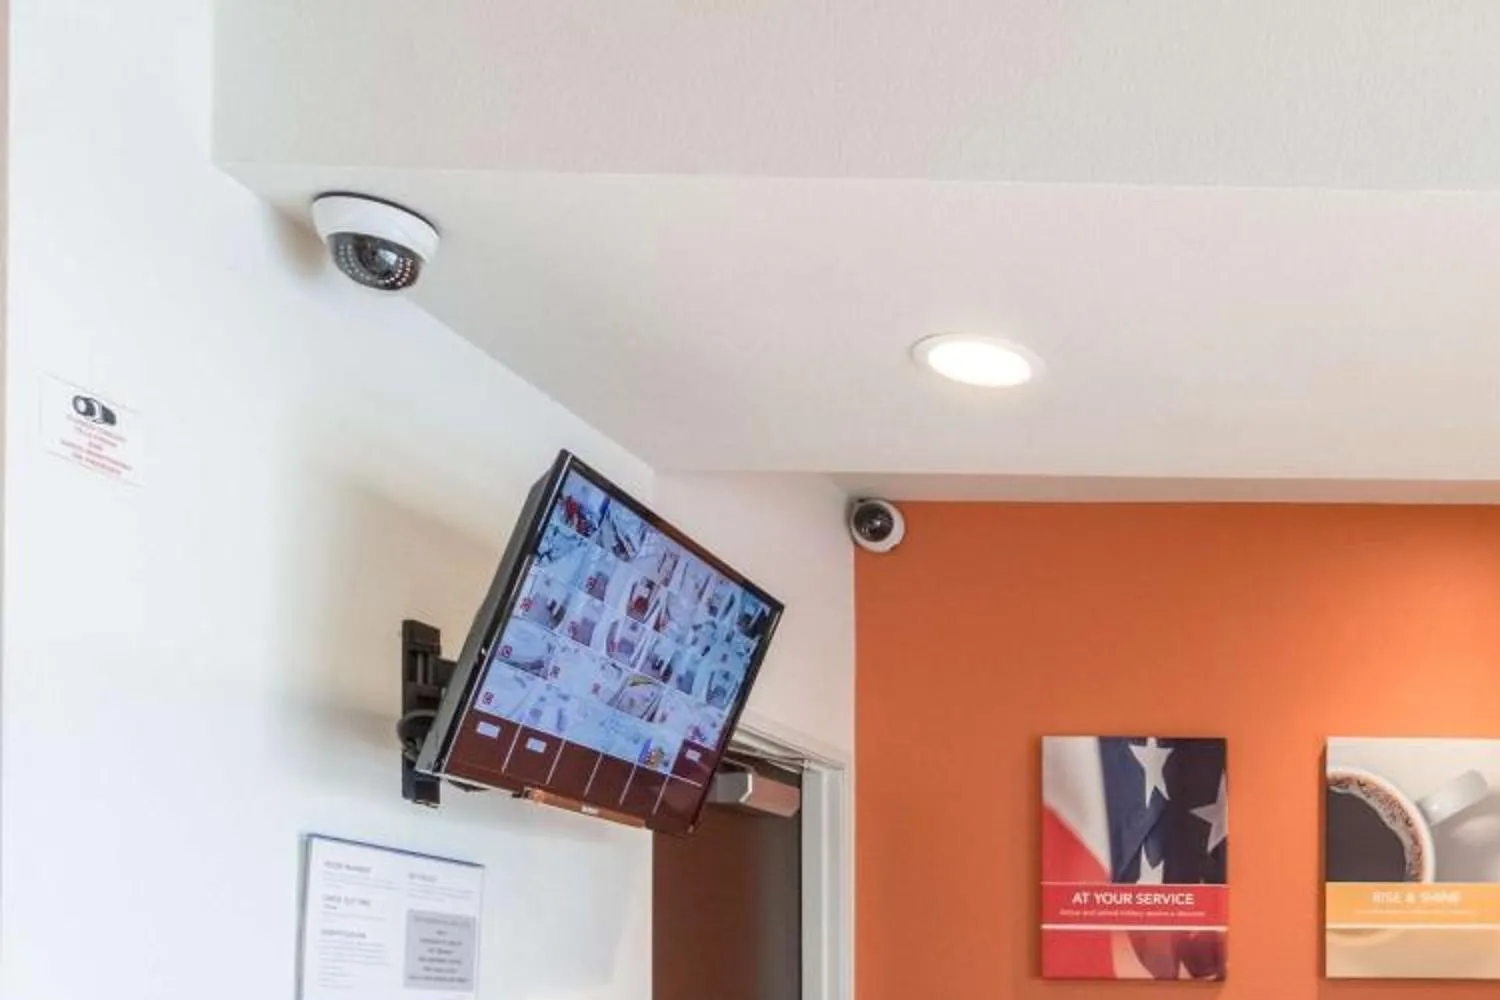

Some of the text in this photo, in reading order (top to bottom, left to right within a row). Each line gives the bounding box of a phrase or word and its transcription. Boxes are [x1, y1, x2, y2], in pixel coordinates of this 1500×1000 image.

[1072, 892, 1195, 905] AT YOUR SERVICE
[1372, 891, 1401, 903] RISE
[1406, 891, 1415, 903] &
